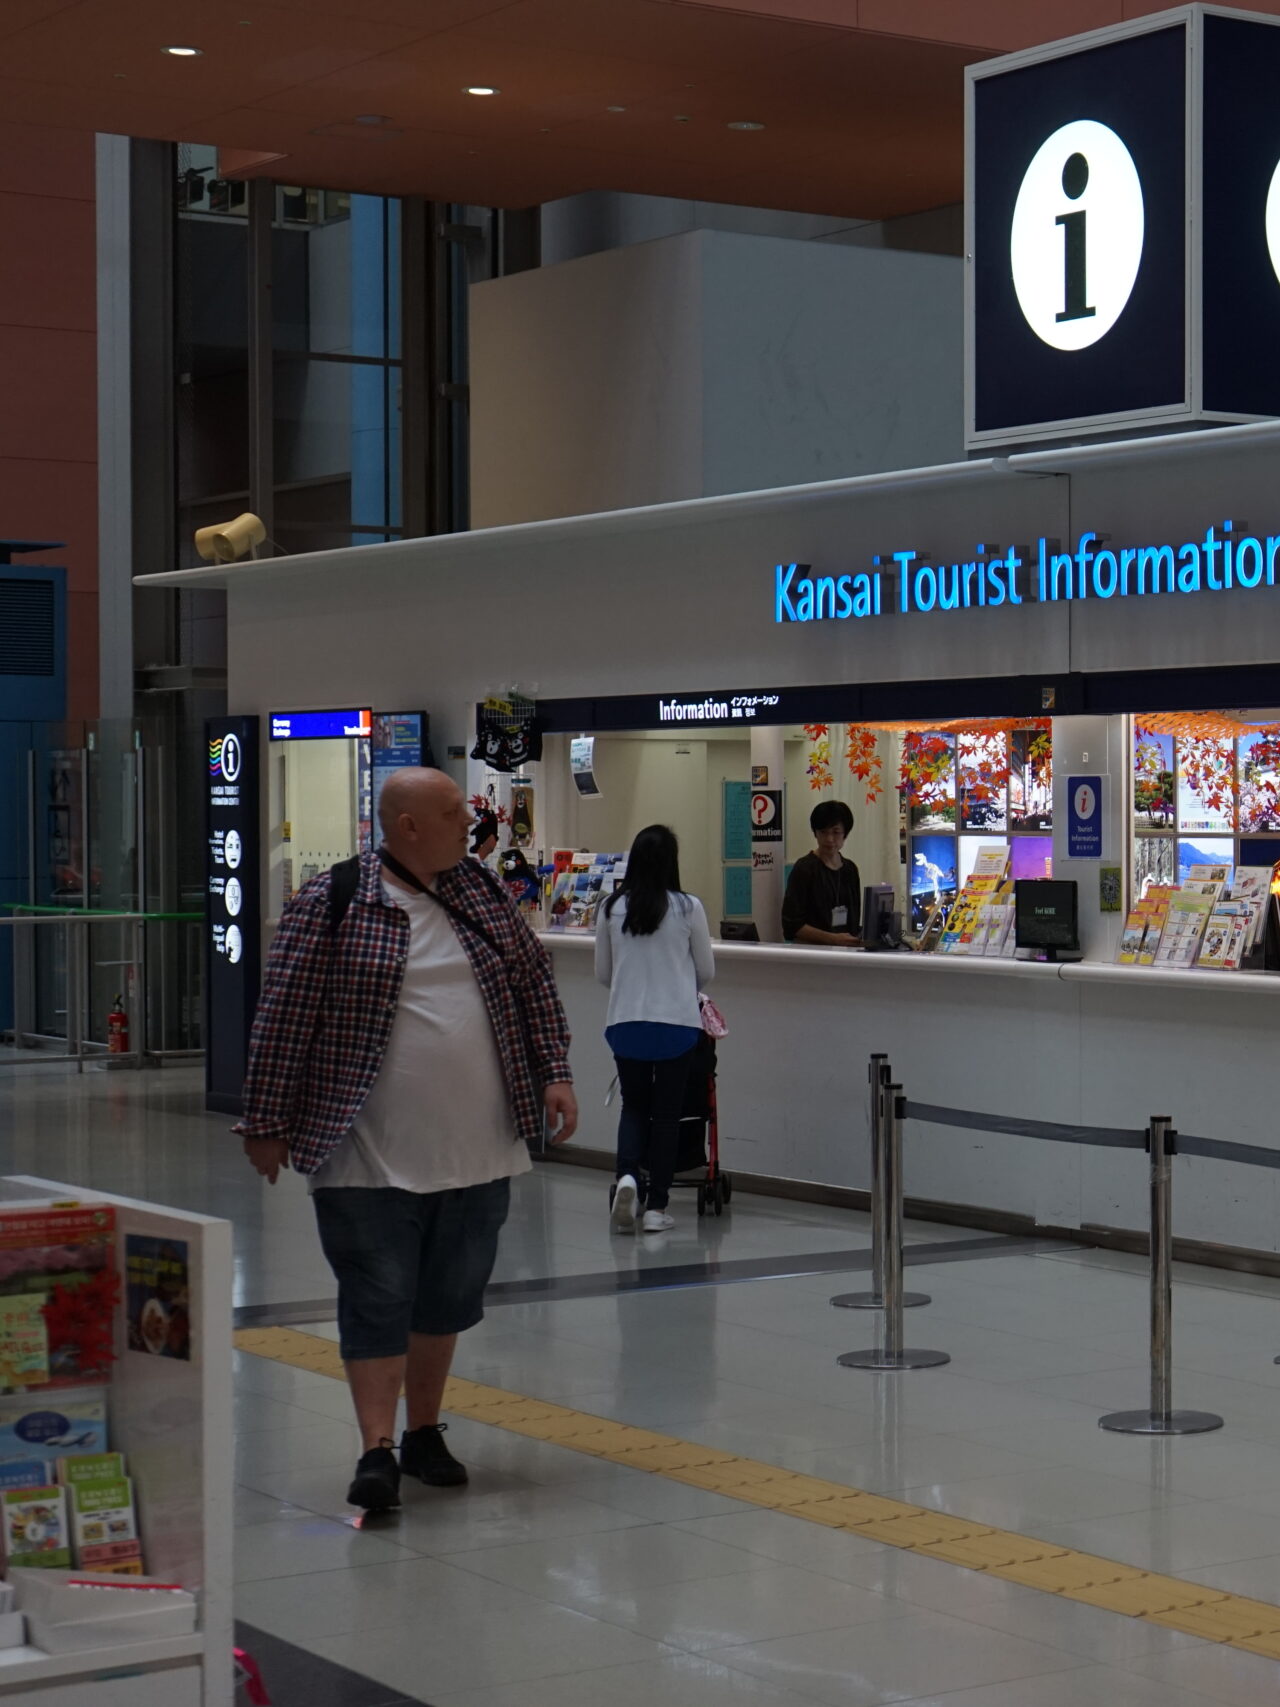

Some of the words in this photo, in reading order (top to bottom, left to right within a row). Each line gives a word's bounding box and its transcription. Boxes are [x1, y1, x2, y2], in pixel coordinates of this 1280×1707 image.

[776, 556, 880, 622] Kansai
[893, 544, 1022, 612] Tourist
[659, 697, 729, 721] Information
